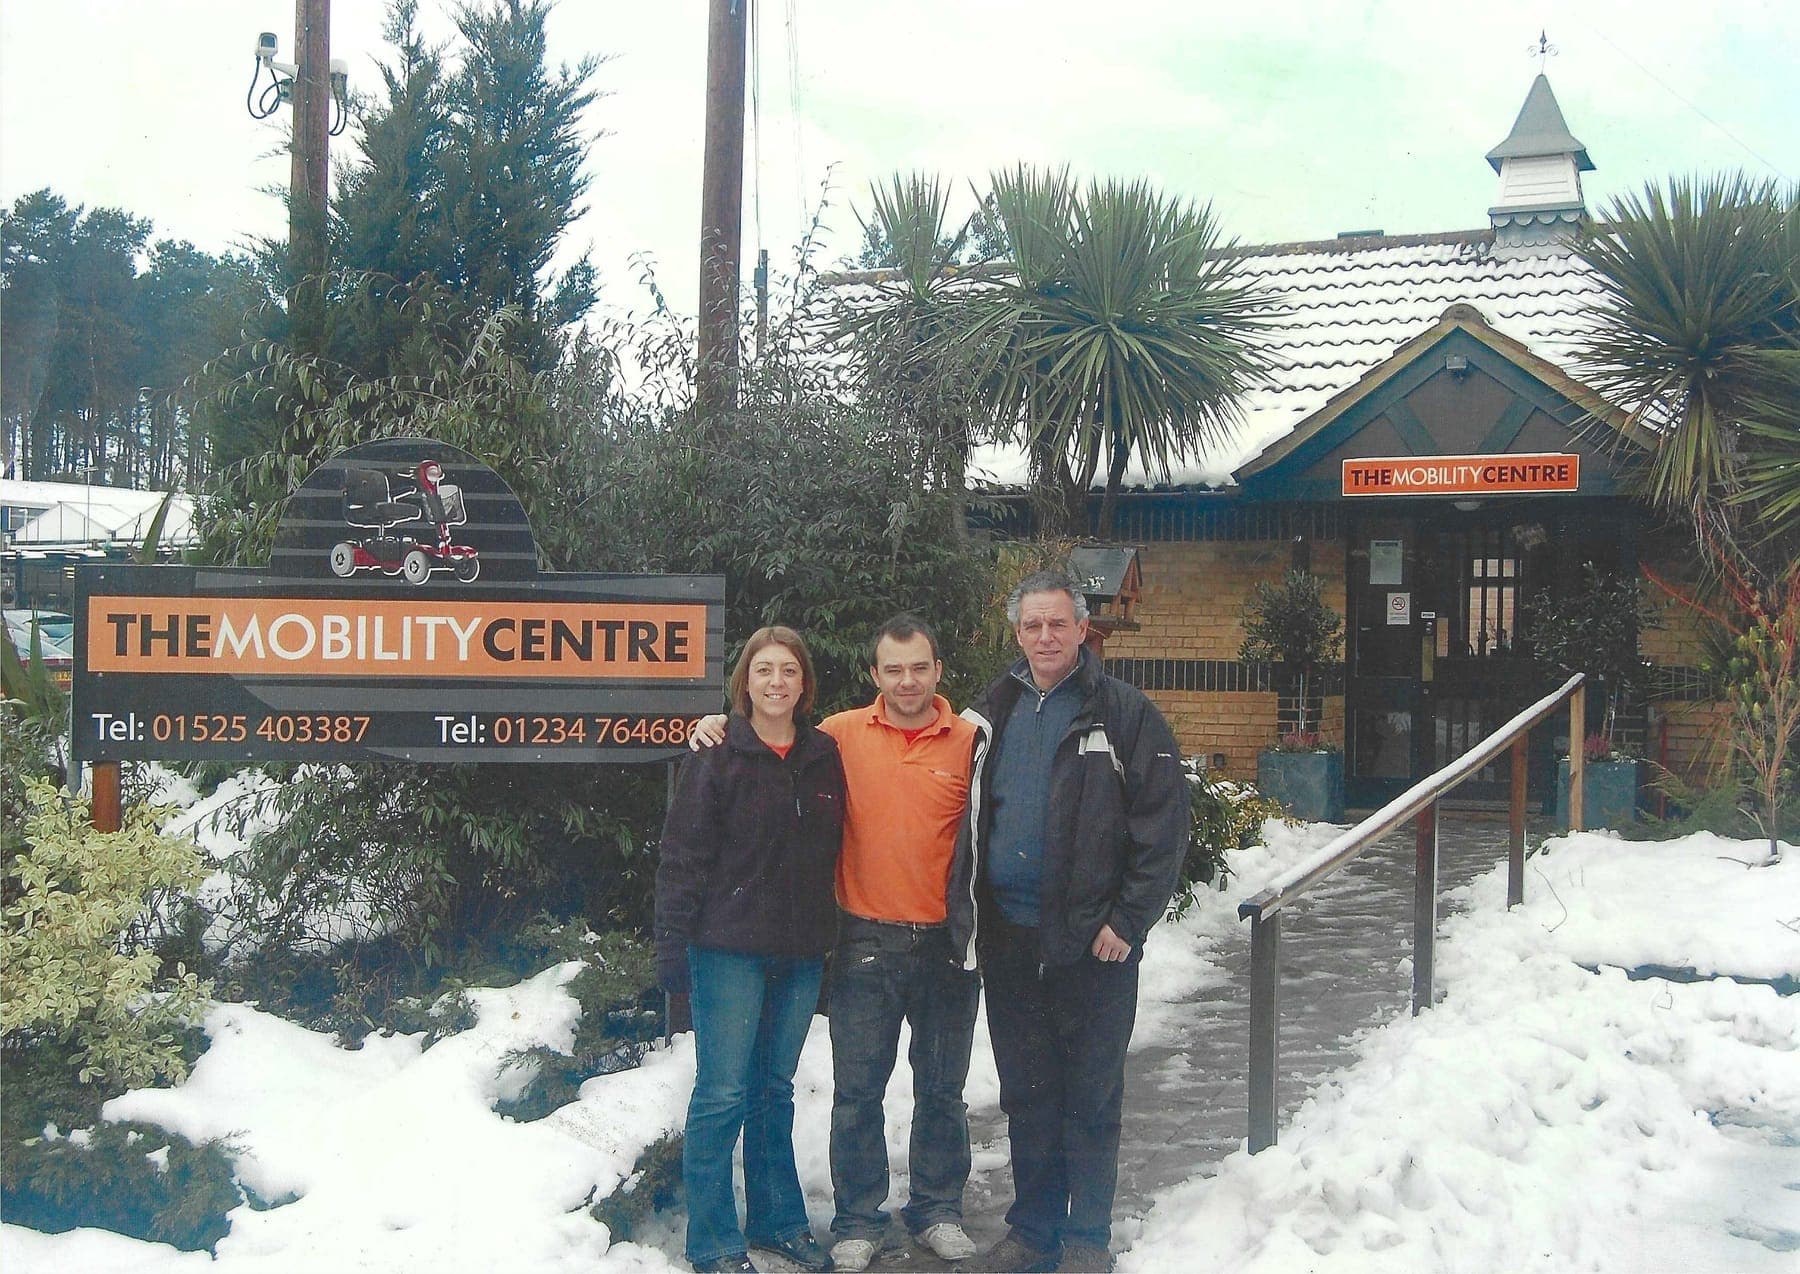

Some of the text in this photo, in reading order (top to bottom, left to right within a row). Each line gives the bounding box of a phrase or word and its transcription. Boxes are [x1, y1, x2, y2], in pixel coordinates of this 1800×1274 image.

[92, 713, 371, 742] Tel: 01525 403387
[434, 716, 486, 743] Tel:
[494, 717, 586, 744] 01234
